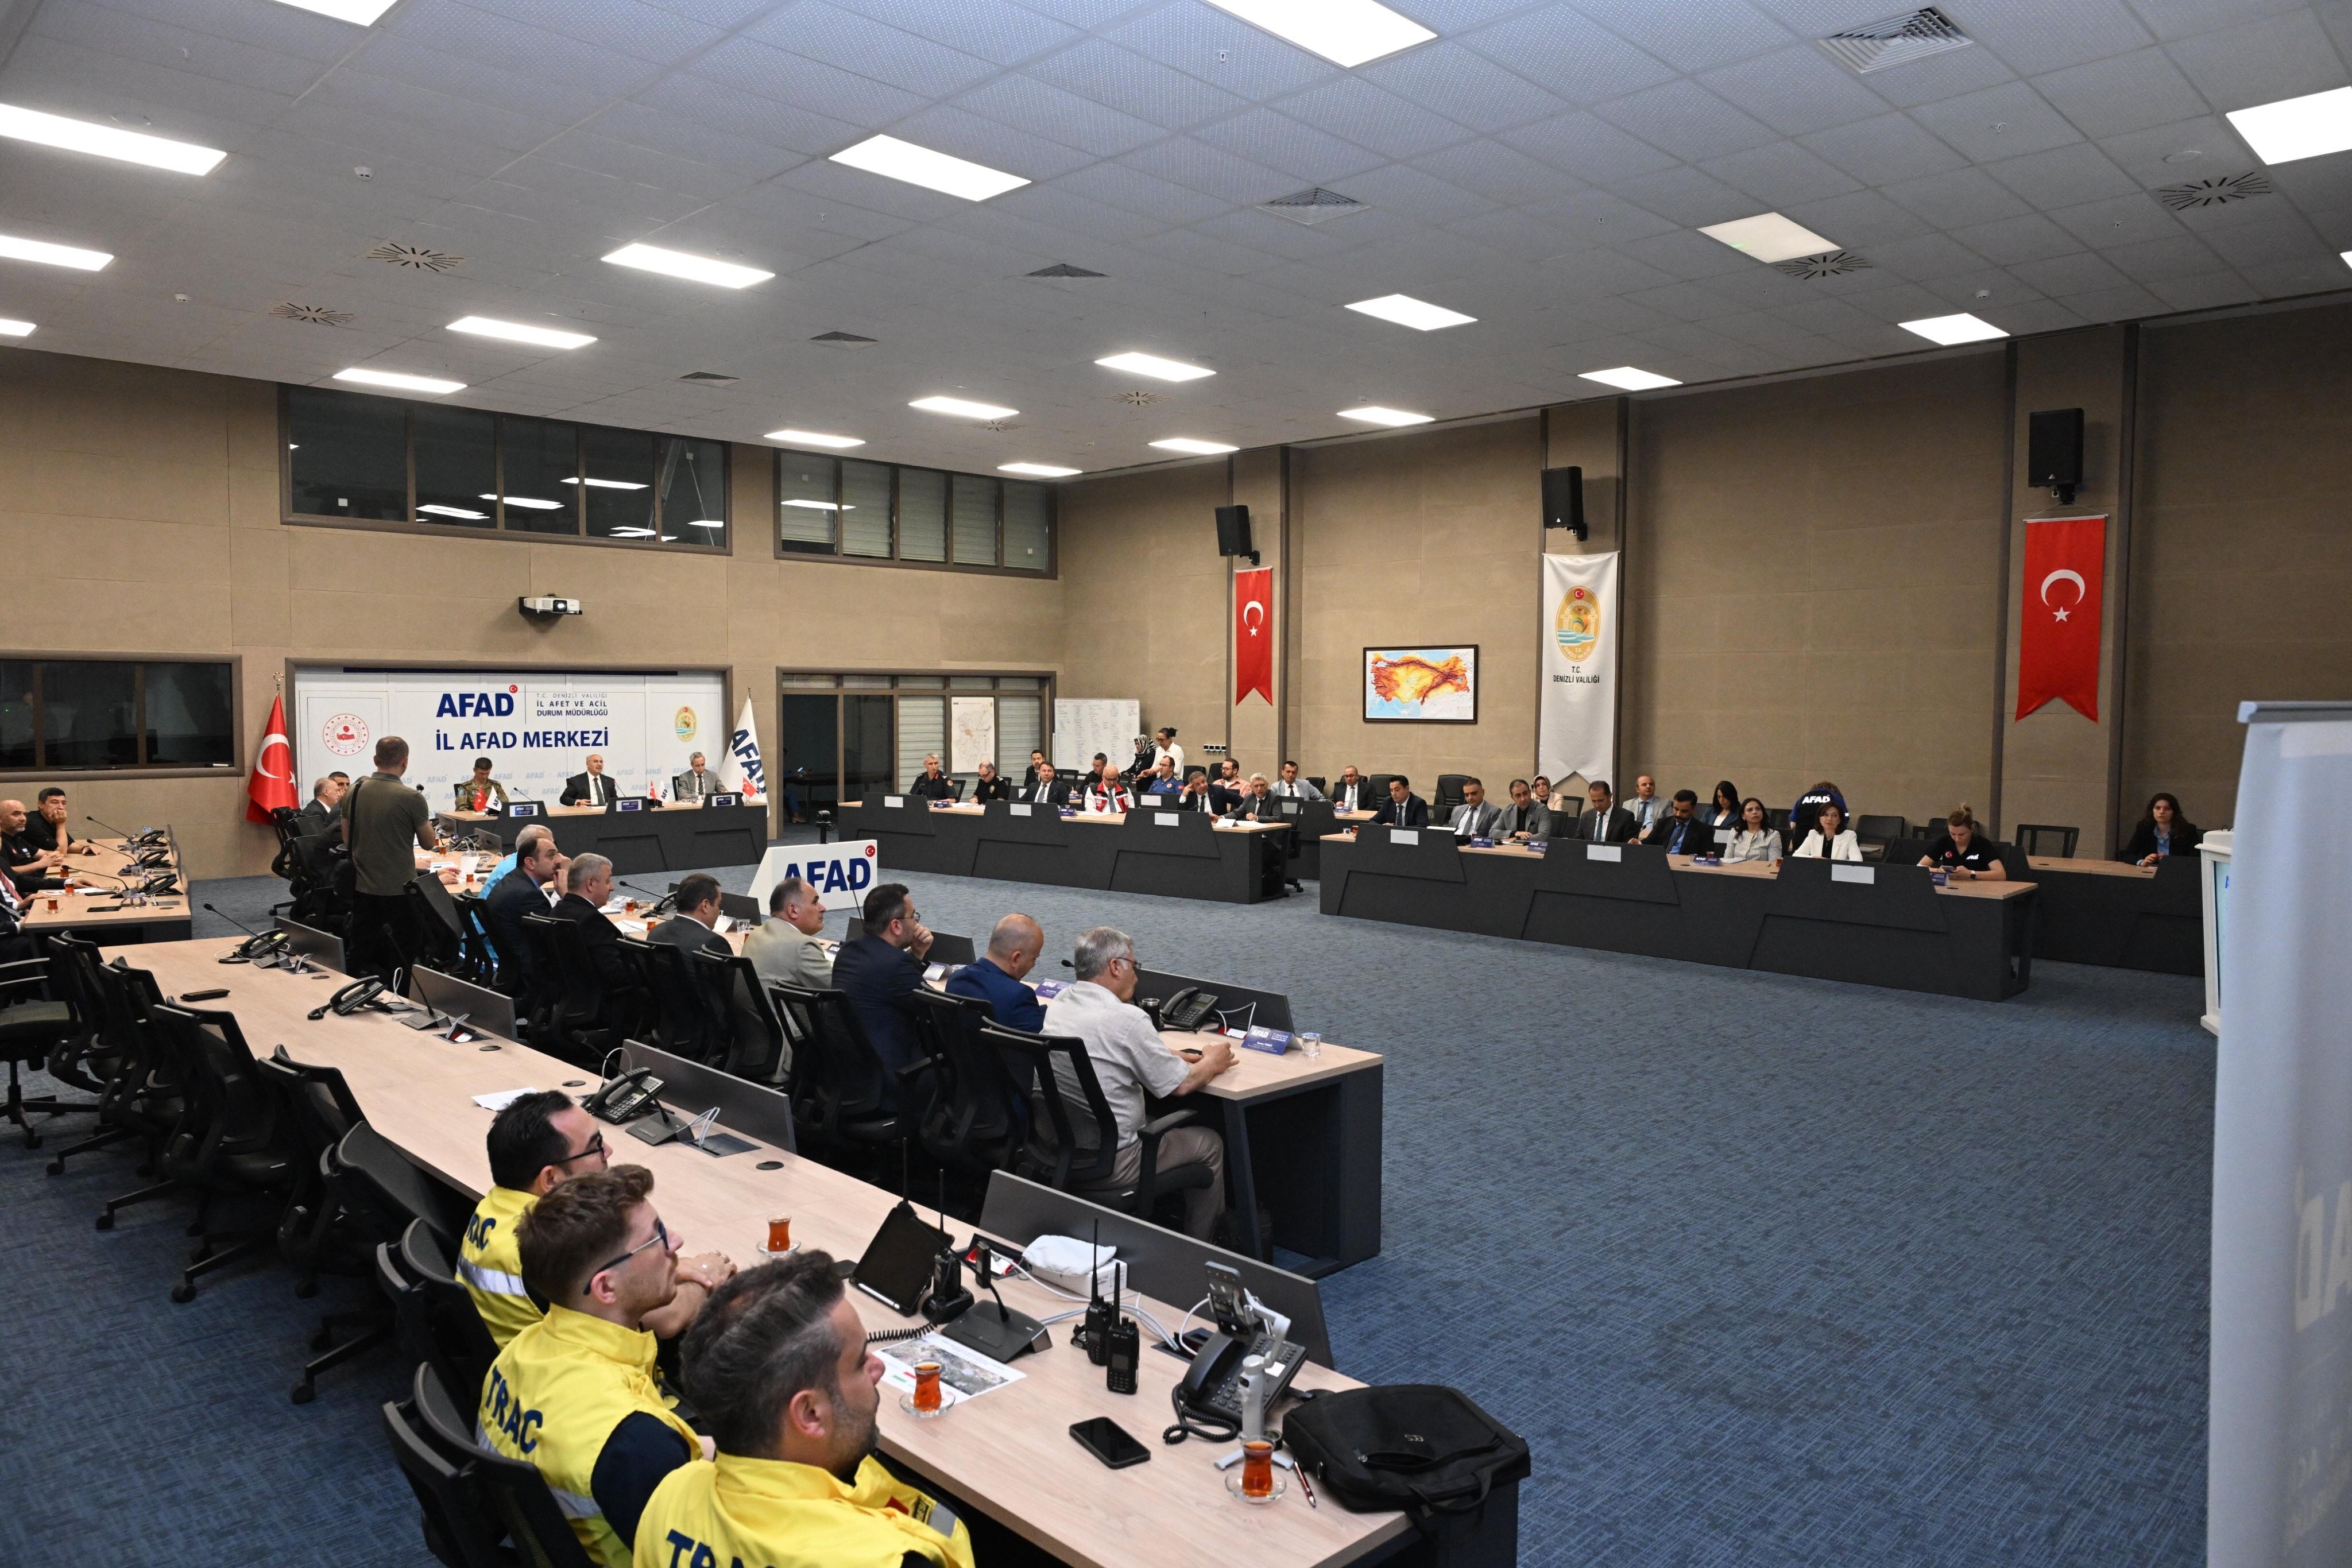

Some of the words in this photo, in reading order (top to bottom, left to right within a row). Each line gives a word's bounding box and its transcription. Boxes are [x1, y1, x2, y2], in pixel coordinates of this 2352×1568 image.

[1553, 674, 1575, 683] DENİZLİ
[1576, 674, 1600, 683] VALİLİĞİ
[436, 692, 514, 718] AFAD
[565, 708, 608, 717] MÜDÜRLÜĞÜ
[436, 729, 455, 750] İL
[459, 731, 517, 750] AFAD
[523, 726, 609, 748] MERKEZİ
[1802, 795, 1831, 804] AFAD
[784, 858, 871, 893] AFAD
[1251, 1029, 1269, 1038] AFAD
[466, 1213, 497, 1251] RAC
[485, 1364, 543, 1455] TRAC
